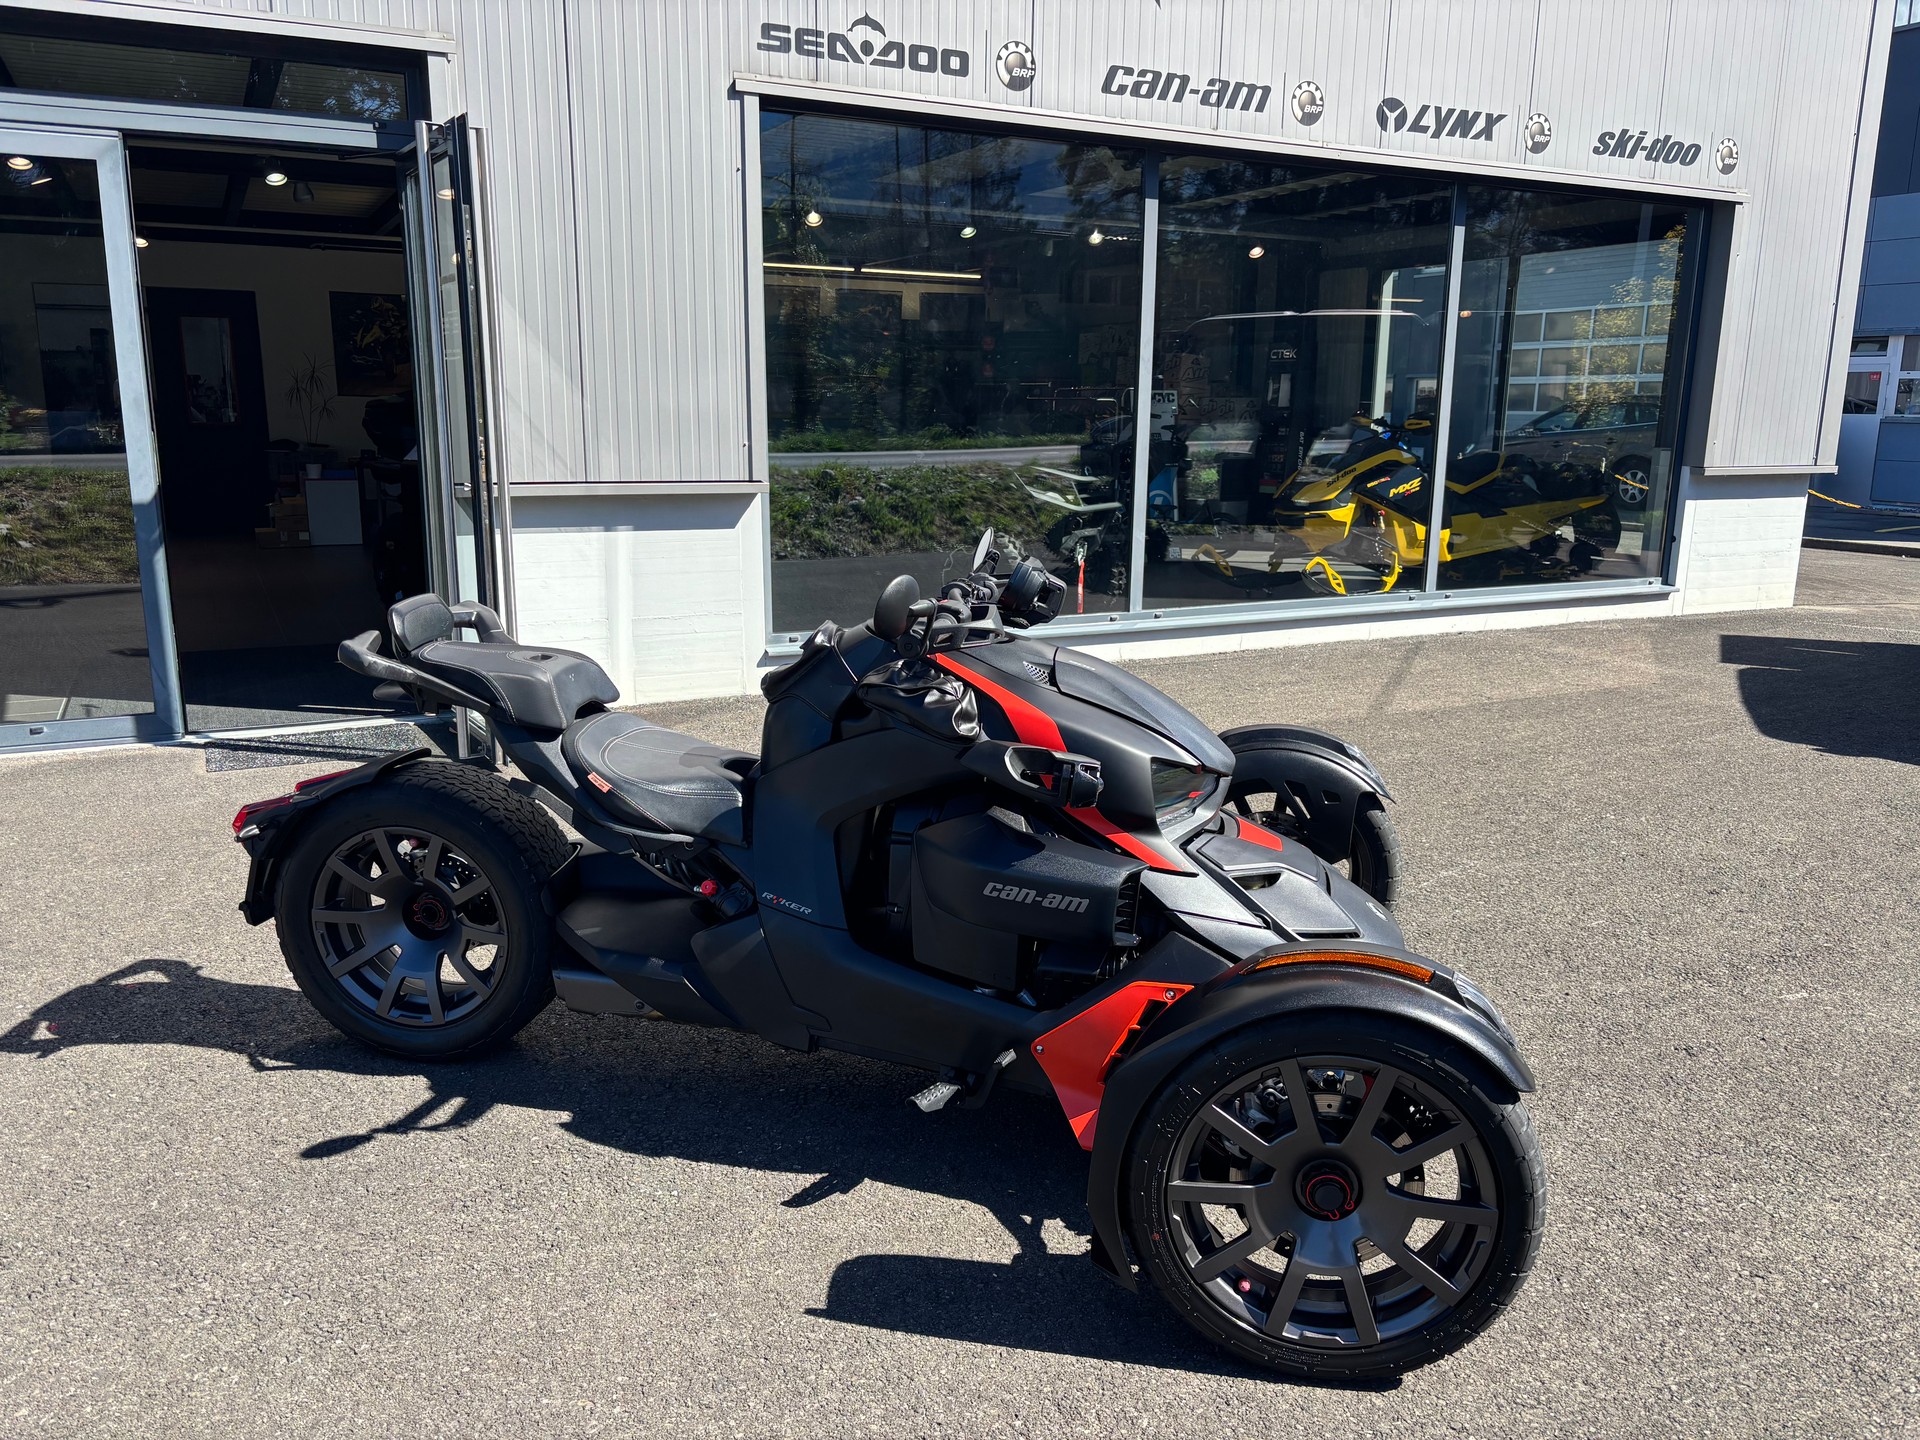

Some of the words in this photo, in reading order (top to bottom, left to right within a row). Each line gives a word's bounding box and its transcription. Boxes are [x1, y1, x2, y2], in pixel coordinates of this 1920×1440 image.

[1011, 67, 1036, 79] BRP
[1303, 104, 1324, 115] BRP
[1406, 104, 1508, 142] LYNX
[1532, 134, 1551, 144] BRP
[1592, 128, 1702, 167] ski-doo
[1723, 157, 1738, 166] BRP
[1270, 348, 1297, 359] CTEK
[1326, 467, 1357, 488] ski-doo
[1389, 476, 1423, 498] MXZ
[761, 891, 813, 915] RYKER
